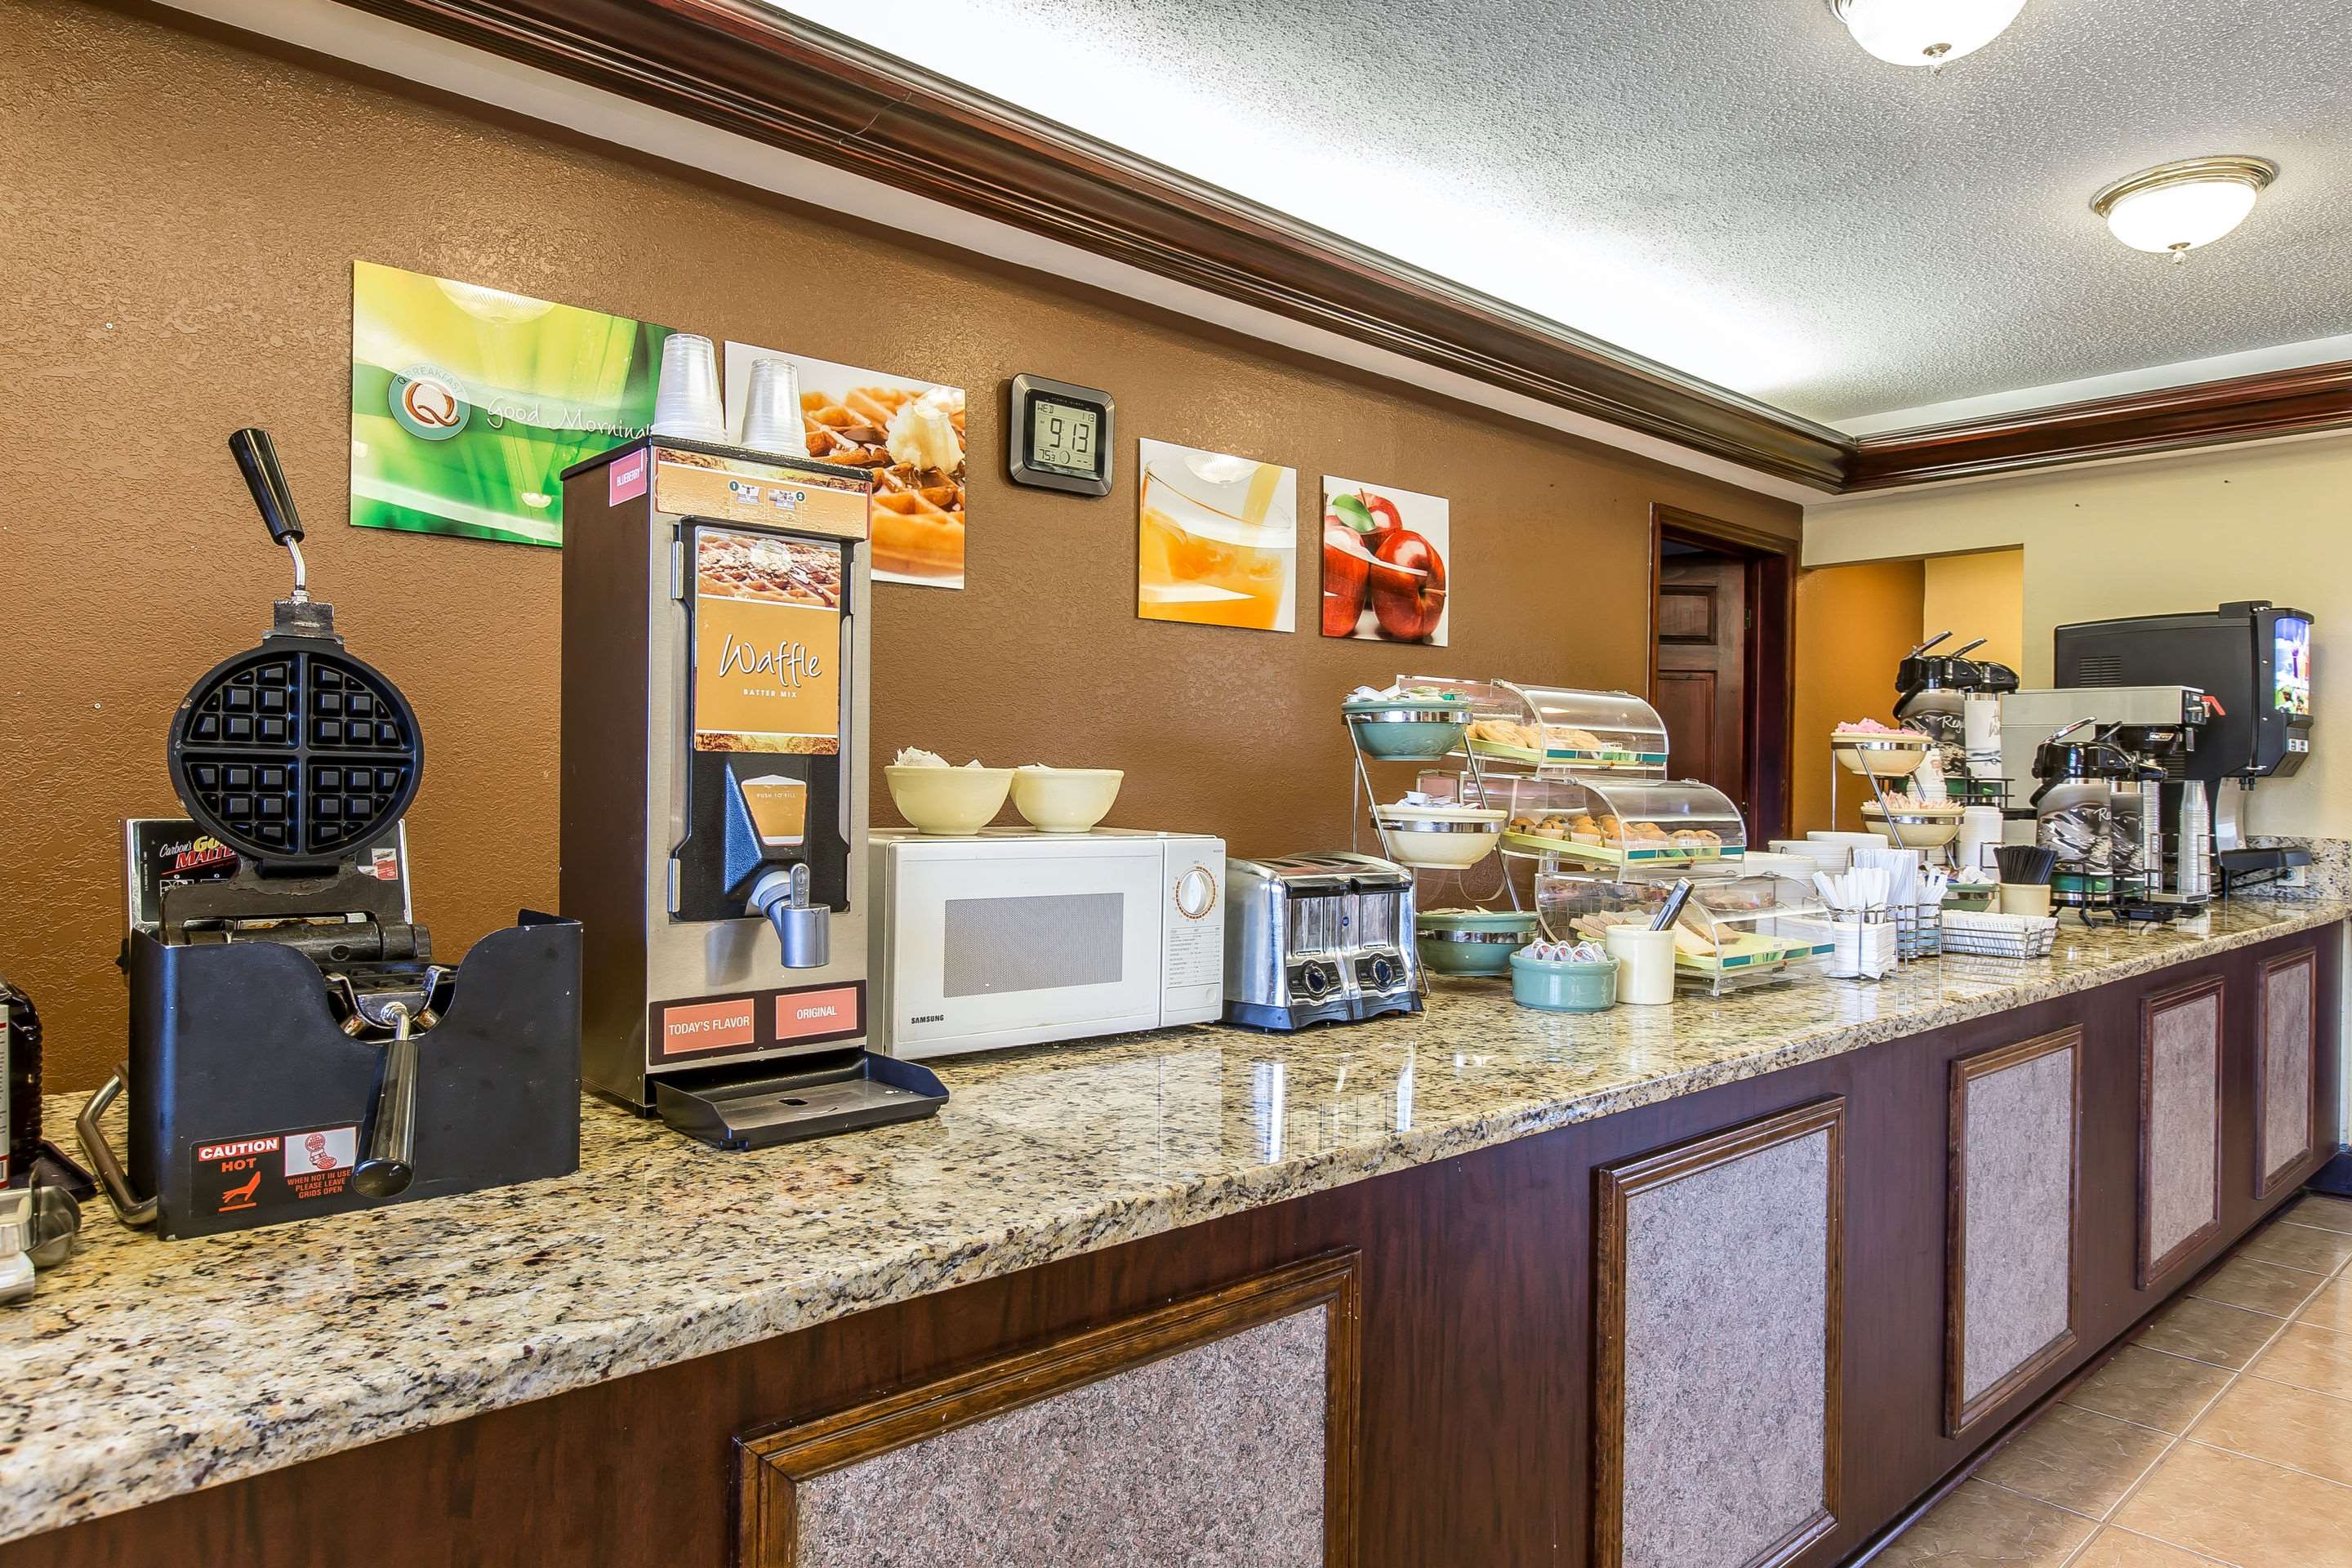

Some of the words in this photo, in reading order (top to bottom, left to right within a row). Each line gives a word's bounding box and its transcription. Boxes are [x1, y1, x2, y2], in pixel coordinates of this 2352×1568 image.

[487, 395, 541, 429] Good
[617, 466, 640, 487] BLUEBERRY
[719, 634, 822, 688] Waffle
[743, 688, 776, 697] BATTER
[780, 690, 797, 698] MIX
[159, 840, 192, 858] Carbon's
[797, 866, 805, 906] PUSH
[796, 1005, 837, 1020] ORIGINAL
[911, 1014, 944, 1024] SAMSUNG
[668, 1021, 710, 1036] TODAY'S
[712, 1016, 750, 1031] FLAVOR
[200, 1139, 278, 1160] CAUTION
[221, 1157, 257, 1173] HOT
[287, 1176, 310, 1187] WHEN
[311, 1174, 326, 1183] NOT
[327, 1172, 336, 1181] IN
[336, 1169, 351, 1178] USE
[295, 1181, 323, 1192] PLEASE
[324, 1178, 346, 1187] LEAVE
[298, 1188, 322, 1199] GRIDS
[323, 1186, 343, 1196] OPEN
